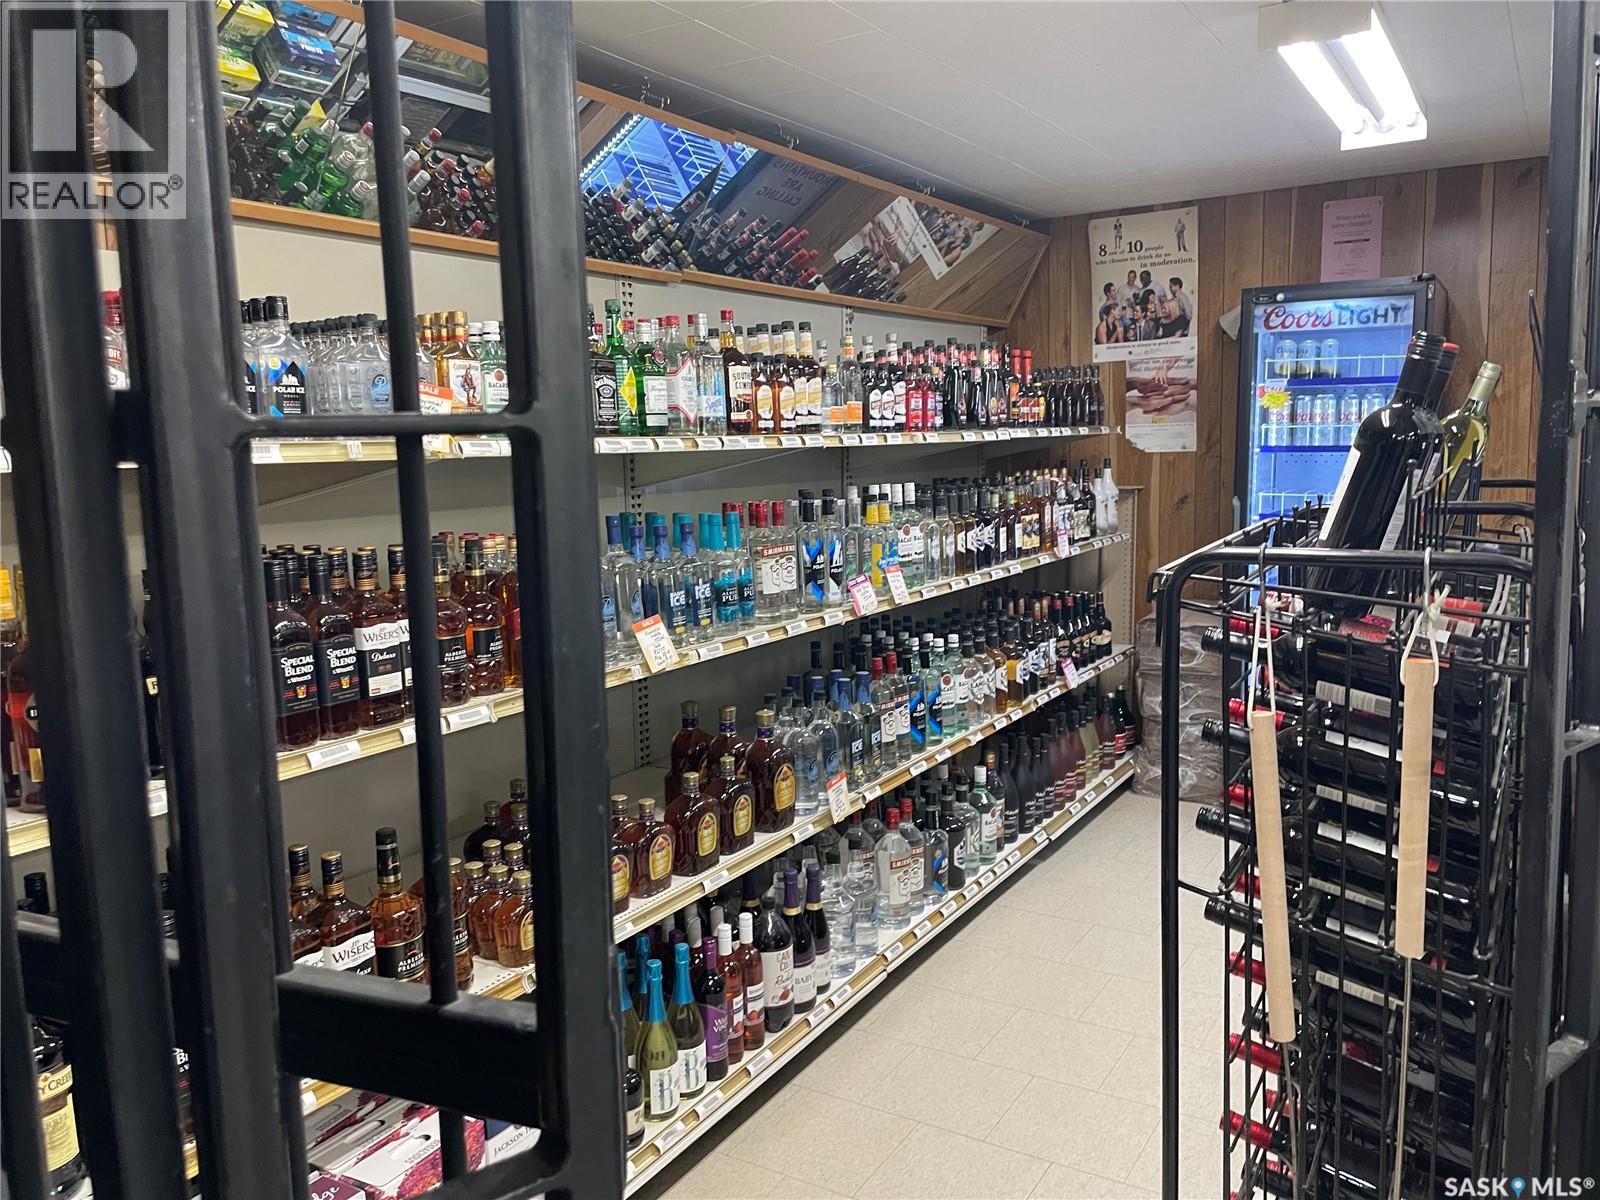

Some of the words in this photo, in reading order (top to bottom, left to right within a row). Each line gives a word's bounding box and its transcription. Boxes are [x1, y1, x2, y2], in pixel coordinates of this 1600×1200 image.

[1099, 244, 1107, 257] 8
[1127, 240, 1143, 254] 10
[1137, 253, 1153, 261] drink
[1149, 257, 1195, 267] moderation.
[1263, 305, 1335, 330] Coors
[1337, 306, 1402, 326] LIGHT
[273, 385, 295, 394] POLAR
[295, 386, 306, 394] ICE
[670, 592, 686, 607] ICE
[695, 585, 712, 600] ICE
[327, 646, 358, 660] SPECIAL
[280, 654, 316, 669] SPECIAL
[330, 655, 357, 668] BLEND
[284, 664, 314, 678] BLEND
